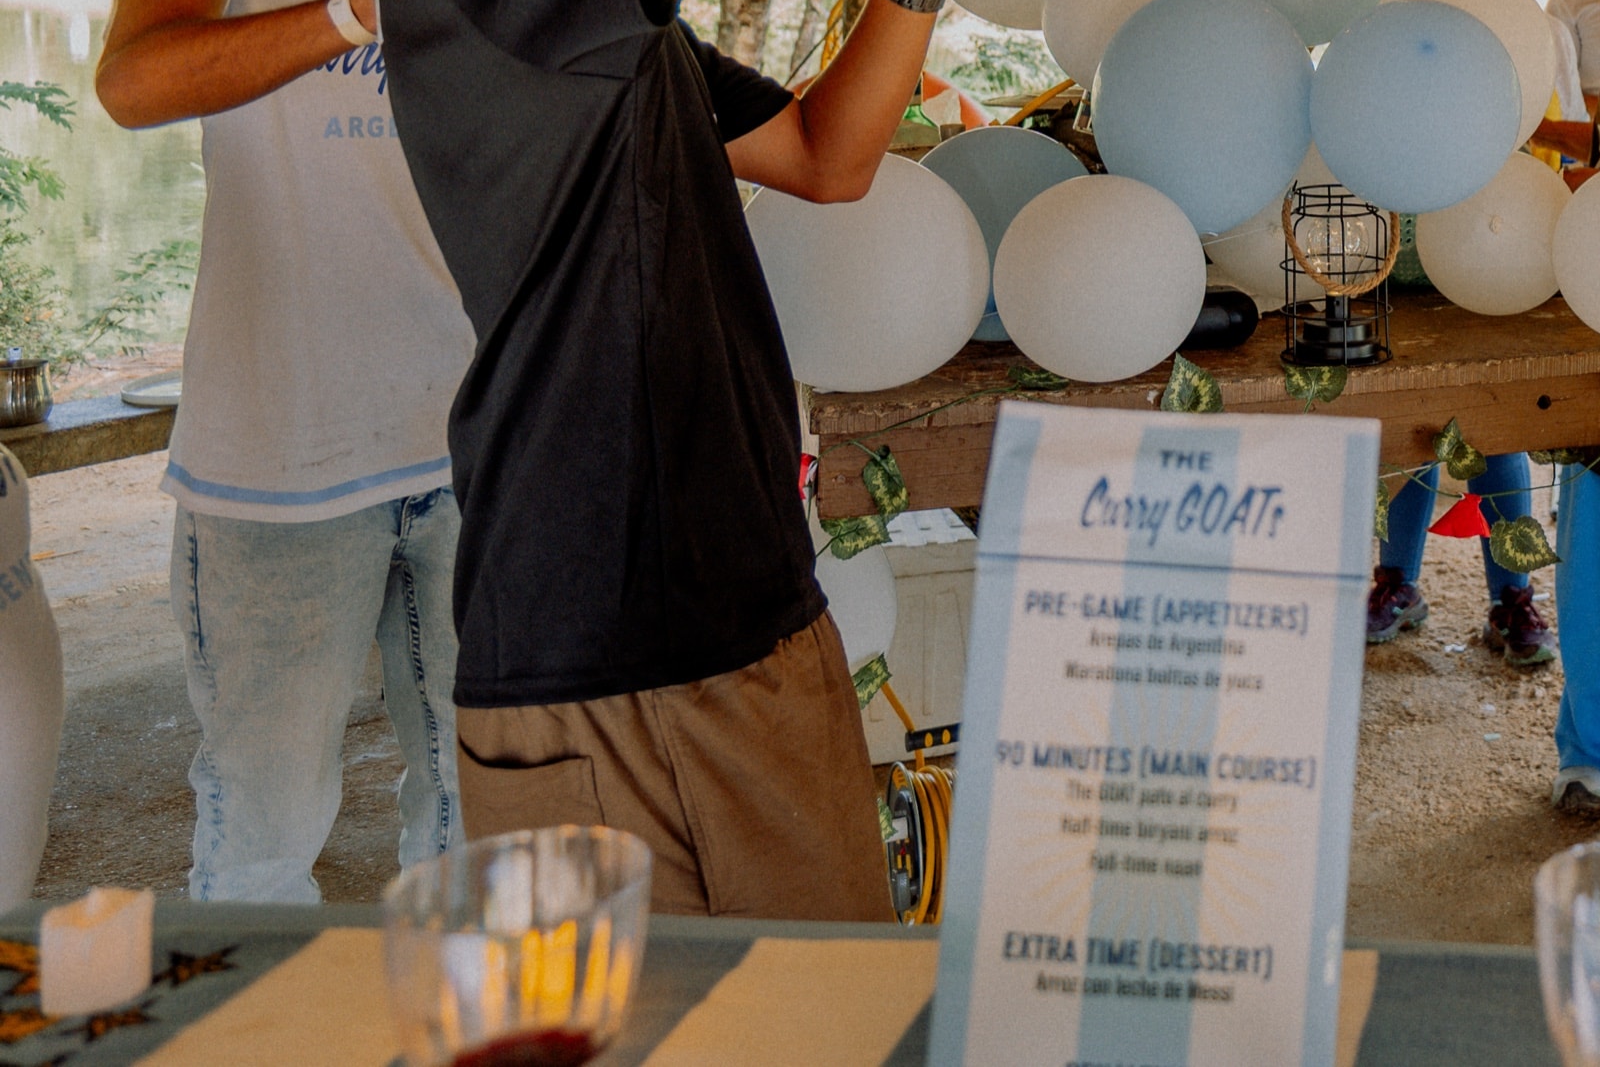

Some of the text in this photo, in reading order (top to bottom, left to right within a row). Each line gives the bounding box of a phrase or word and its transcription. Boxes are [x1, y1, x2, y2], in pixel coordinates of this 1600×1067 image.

[1159, 450, 1213, 472] THE
[1081, 476, 1170, 546] Curry
[1024, 590, 1145, 622] PRE-GAME
[996, 740, 1025, 766] 90
[1032, 742, 1131, 773] MINUTES
[1004, 931, 1077, 963] EXTRA
[1086, 936, 1140, 967] TIME
